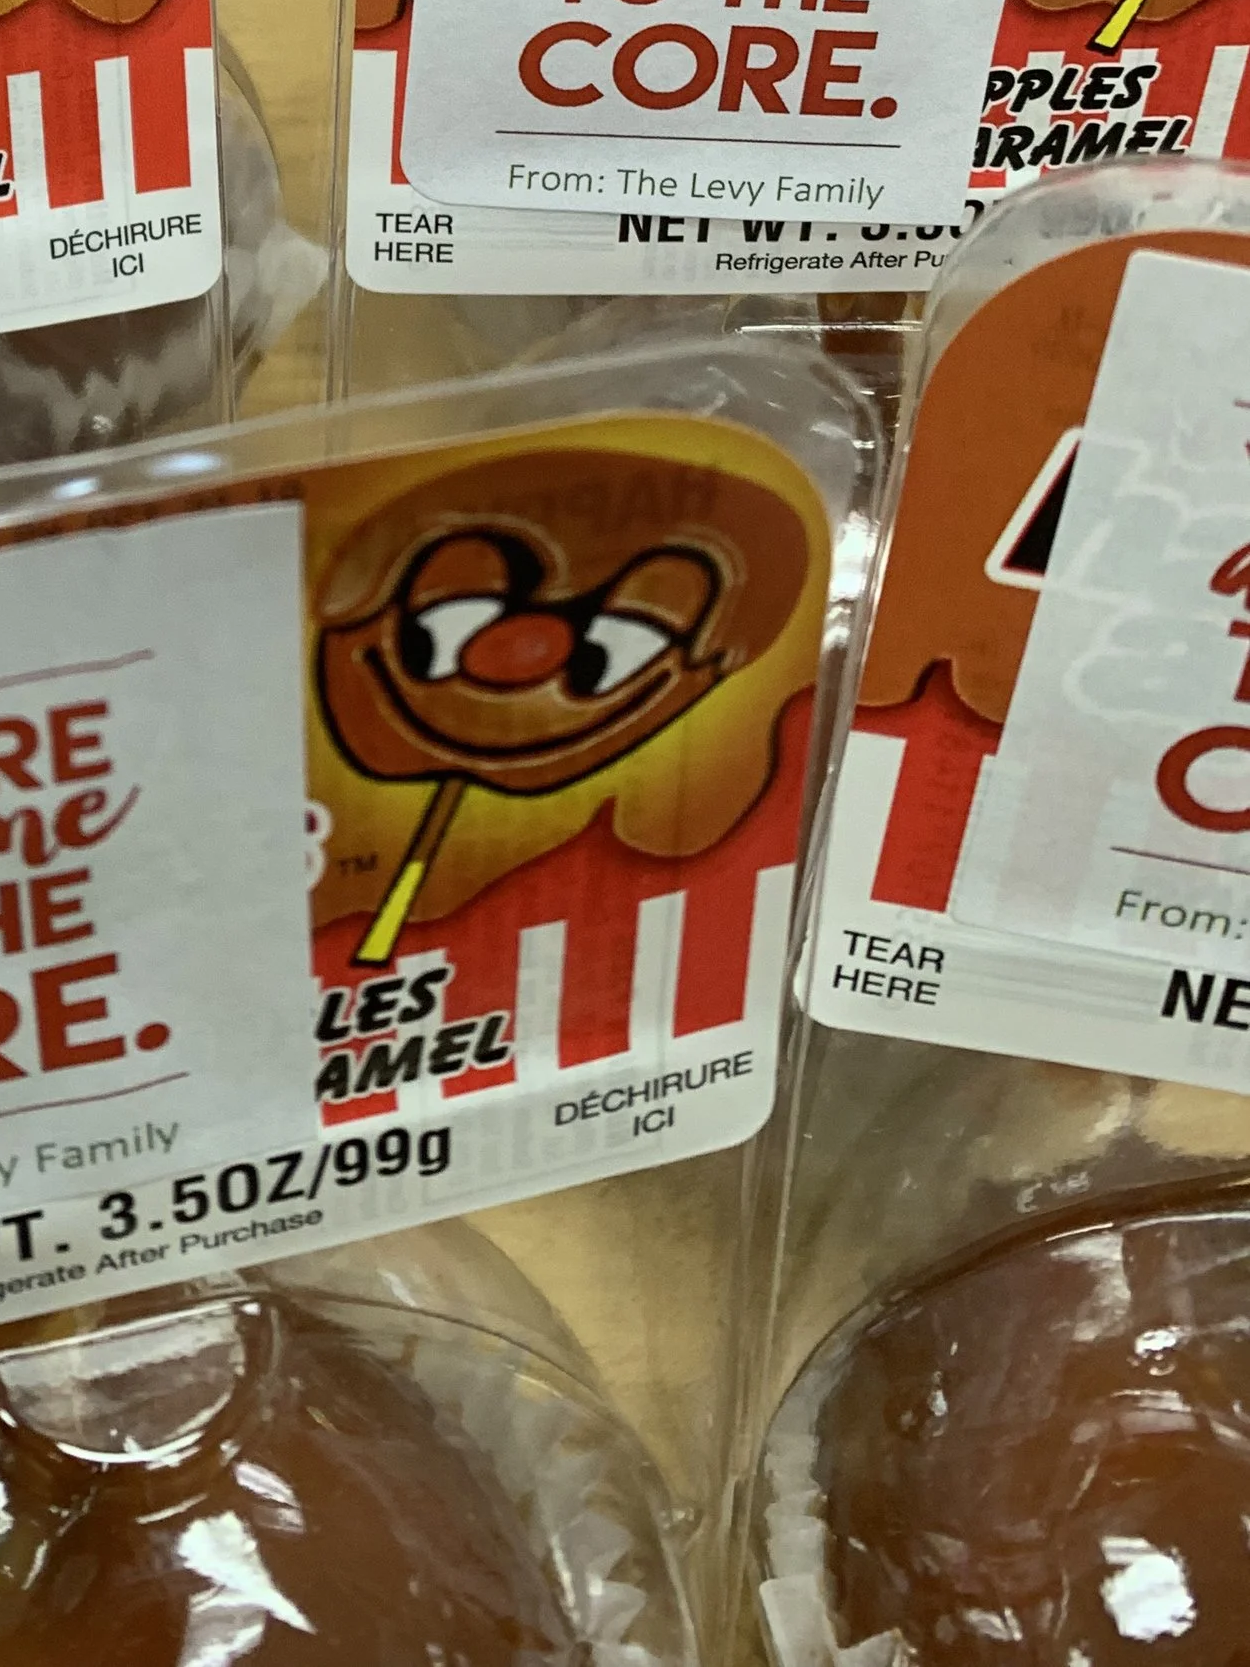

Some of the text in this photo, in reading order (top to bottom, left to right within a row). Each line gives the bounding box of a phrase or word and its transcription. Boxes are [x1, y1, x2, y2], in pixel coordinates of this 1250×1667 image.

[518, 21, 899, 120] CORE.
[507, 164, 886, 210] From: The Levy Family
[49, 214, 203, 261] DÉCHIRURE
[375, 212, 454, 235] TEAR
[111, 253, 146, 279] ICI
[373, 241, 454, 264] HERE
[715, 250, 906, 275] Refrigerate After
[340, 853, 378, 878] TM
[842, 929, 946, 975] TEAR
[832, 964, 941, 1007] HERE
[553, 1049, 755, 1129] DÉCHIRURE
[632, 1106, 675, 1138] ICI
[36, 1118, 183, 1176] Family
[95, 1240, 168, 1278] After
[179, 1206, 324, 1258] Purchase
